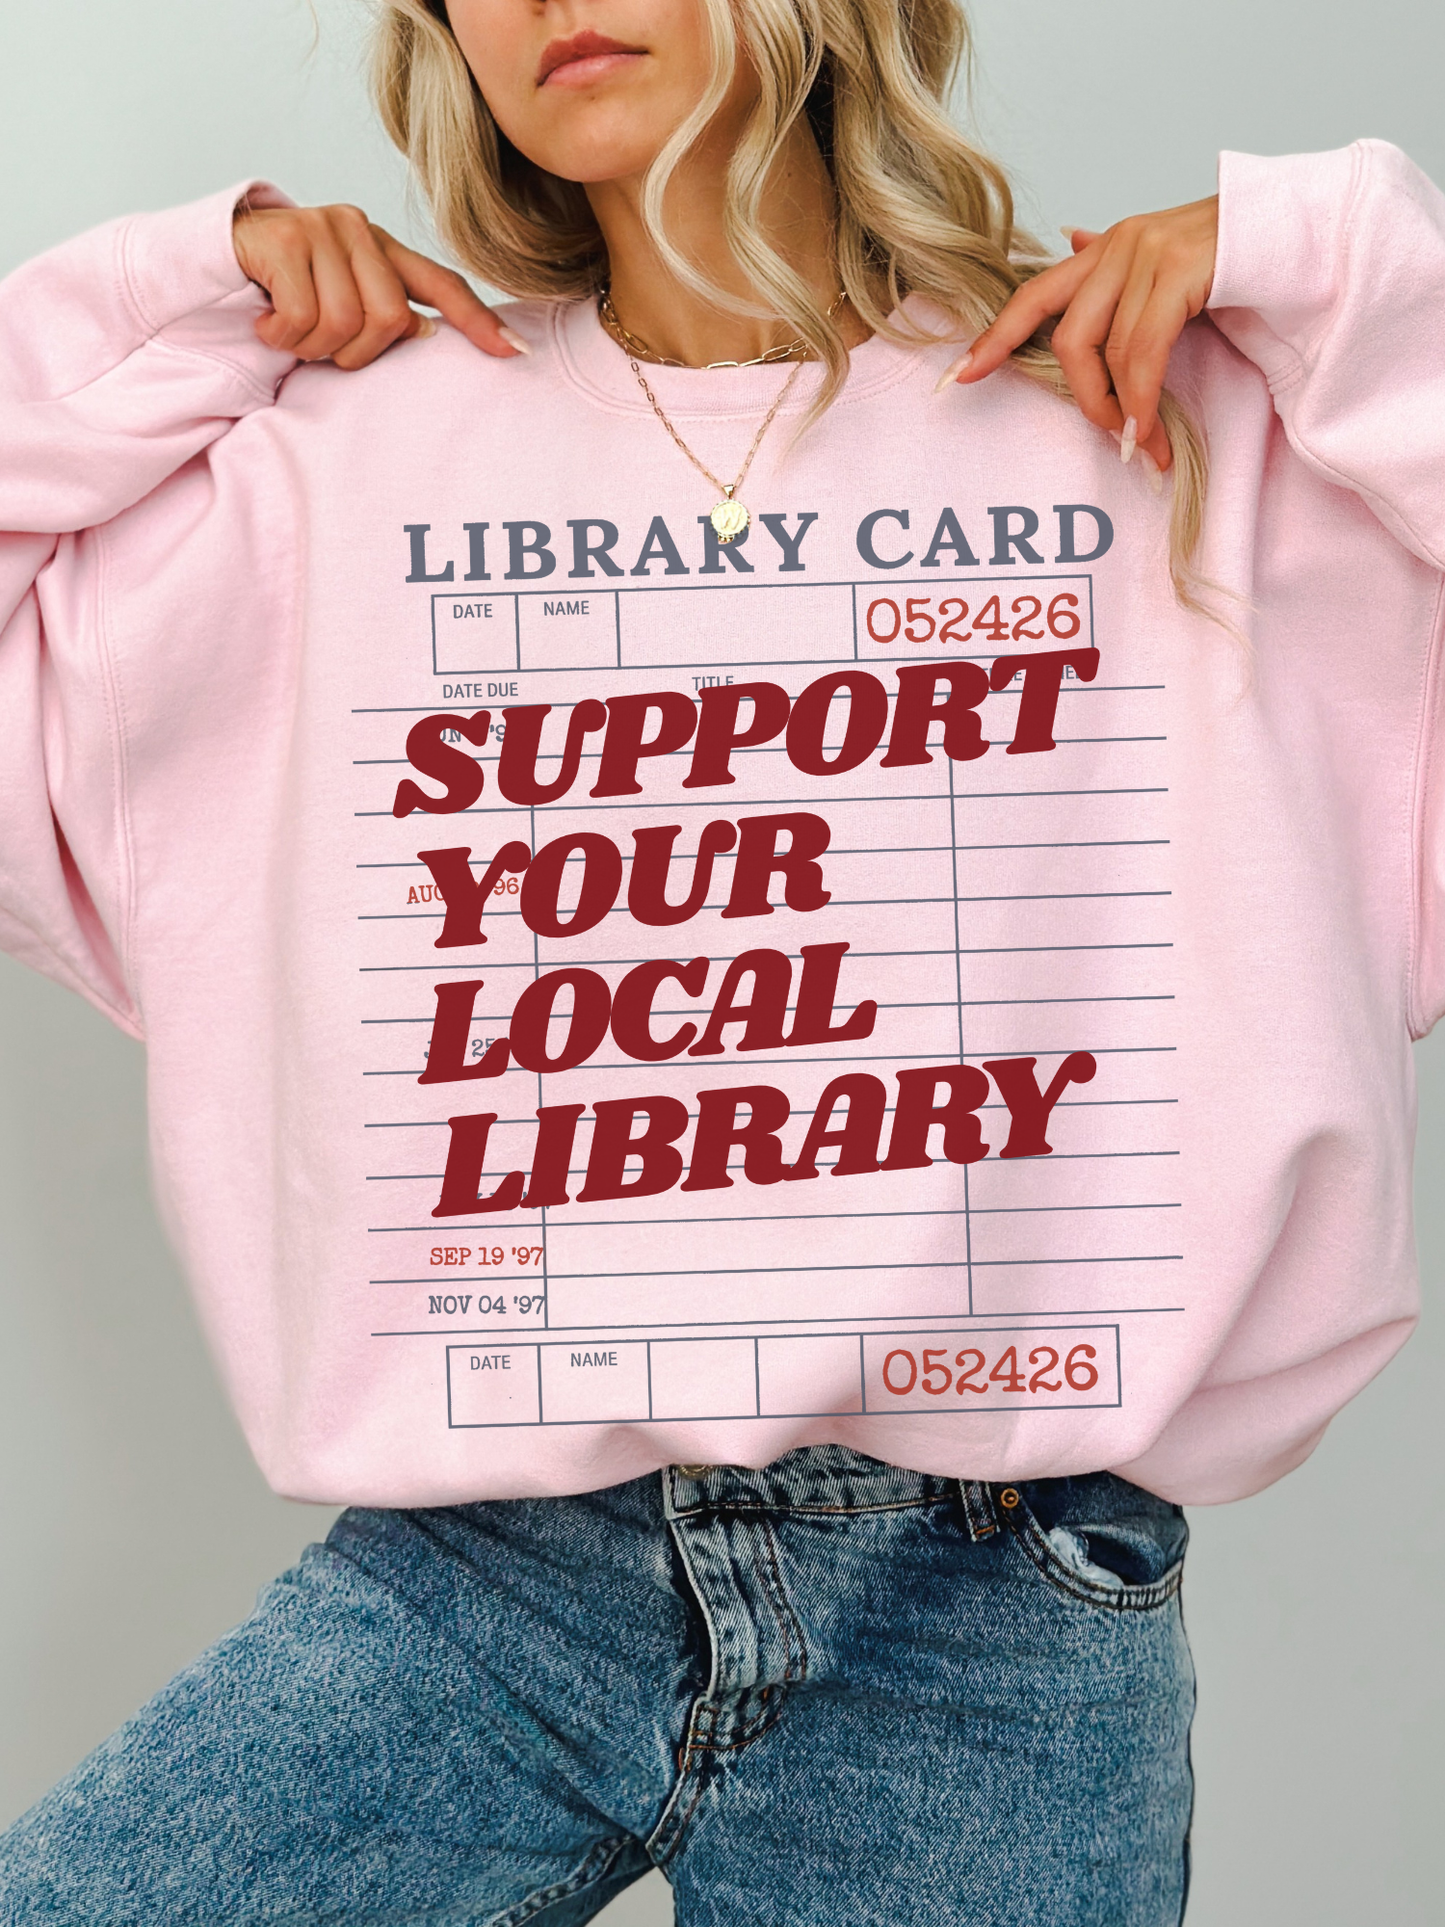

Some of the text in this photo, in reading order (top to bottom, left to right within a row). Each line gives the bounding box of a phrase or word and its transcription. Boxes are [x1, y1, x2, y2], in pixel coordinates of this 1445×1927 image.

[403, 503, 1115, 583] LIBRARY CARD
[453, 603, 493, 619] DATE
[543, 600, 590, 616] NAME
[866, 592, 1081, 644] 052426
[442, 682, 519, 699] DATE DUE
[392, 647, 1100, 819] SUPPORT
[417, 811, 832, 949] YOUR
[417, 942, 878, 1085] LOCAL
[431, 1050, 1097, 1218] LIBRARY
[429, 1246, 543, 1266] SEP 19 '97
[428, 1294, 545, 1315] NOV 04 '97
[470, 1354, 511, 1371] DATE
[570, 1351, 618, 1367] NAME
[882, 1343, 1099, 1396] 052426
